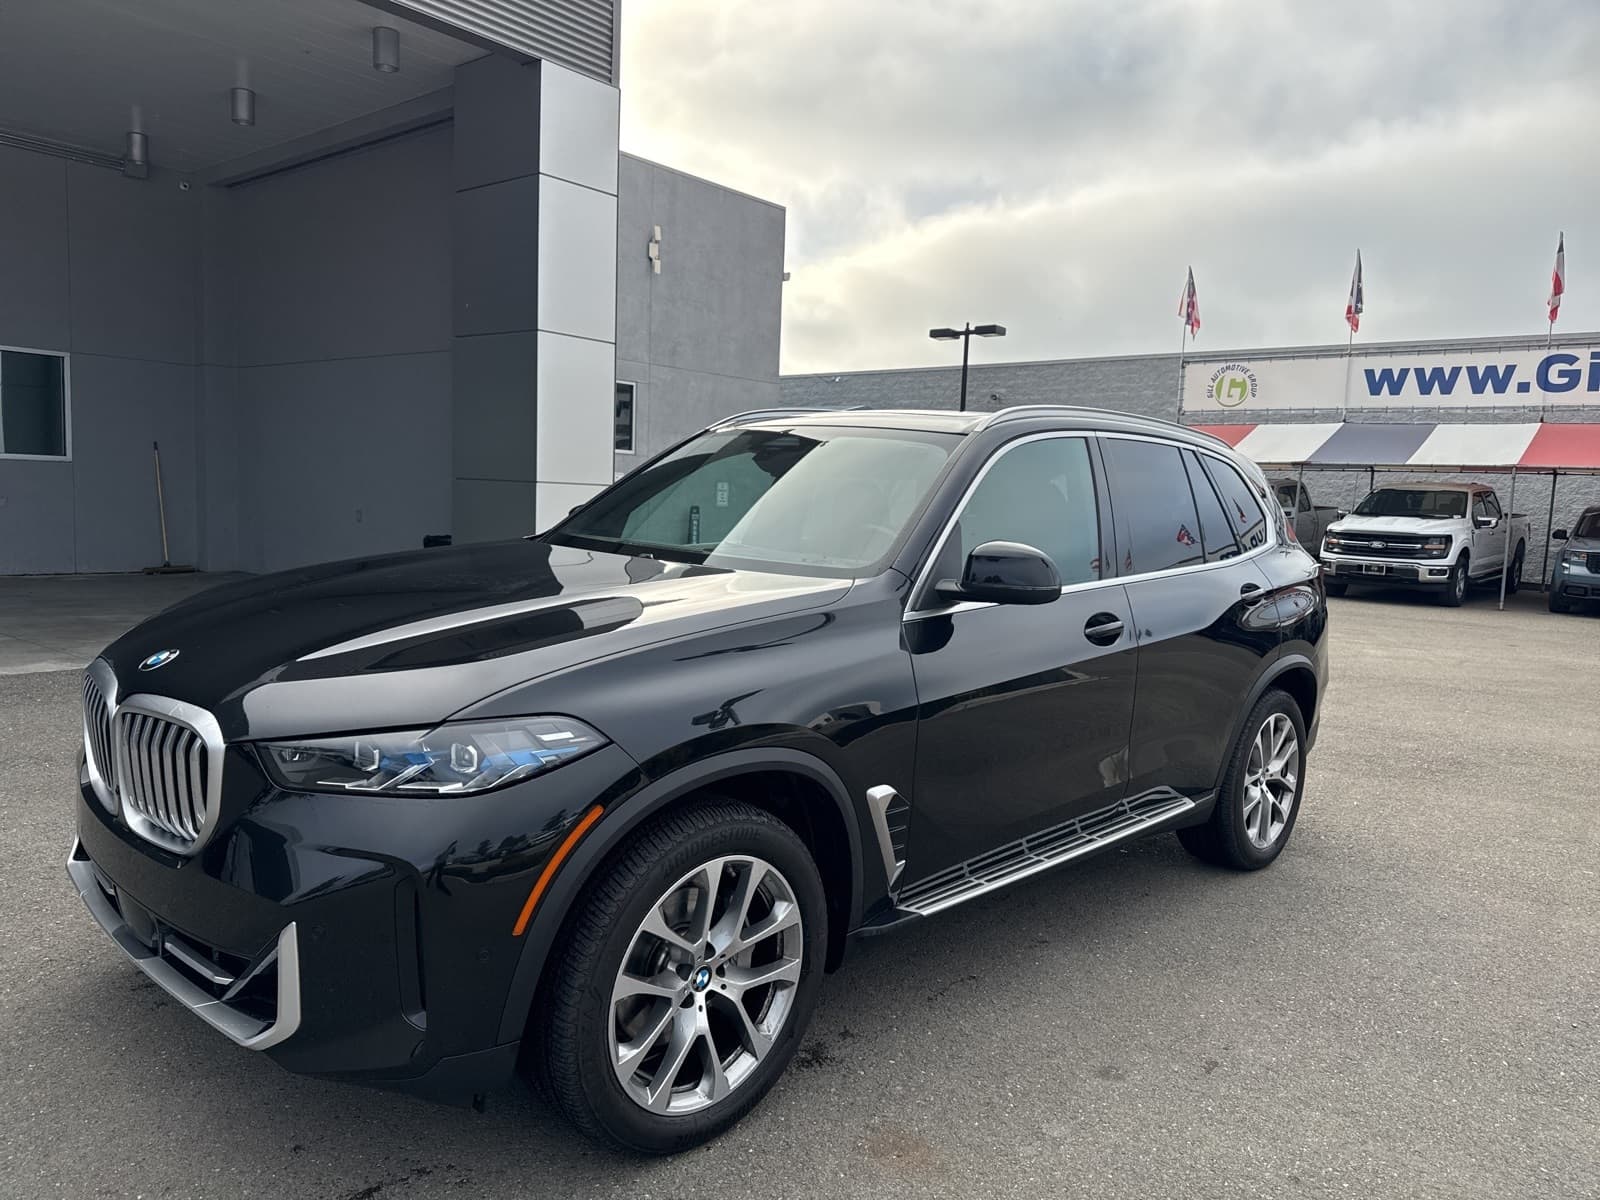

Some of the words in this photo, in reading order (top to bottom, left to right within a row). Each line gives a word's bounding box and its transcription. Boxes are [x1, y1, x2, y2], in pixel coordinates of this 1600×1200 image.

[1210, 364, 1250, 383] AUTOMOTIVE
[1247, 373, 1258, 398] GROUP
[1363, 351, 1600, 396] www.Gi
